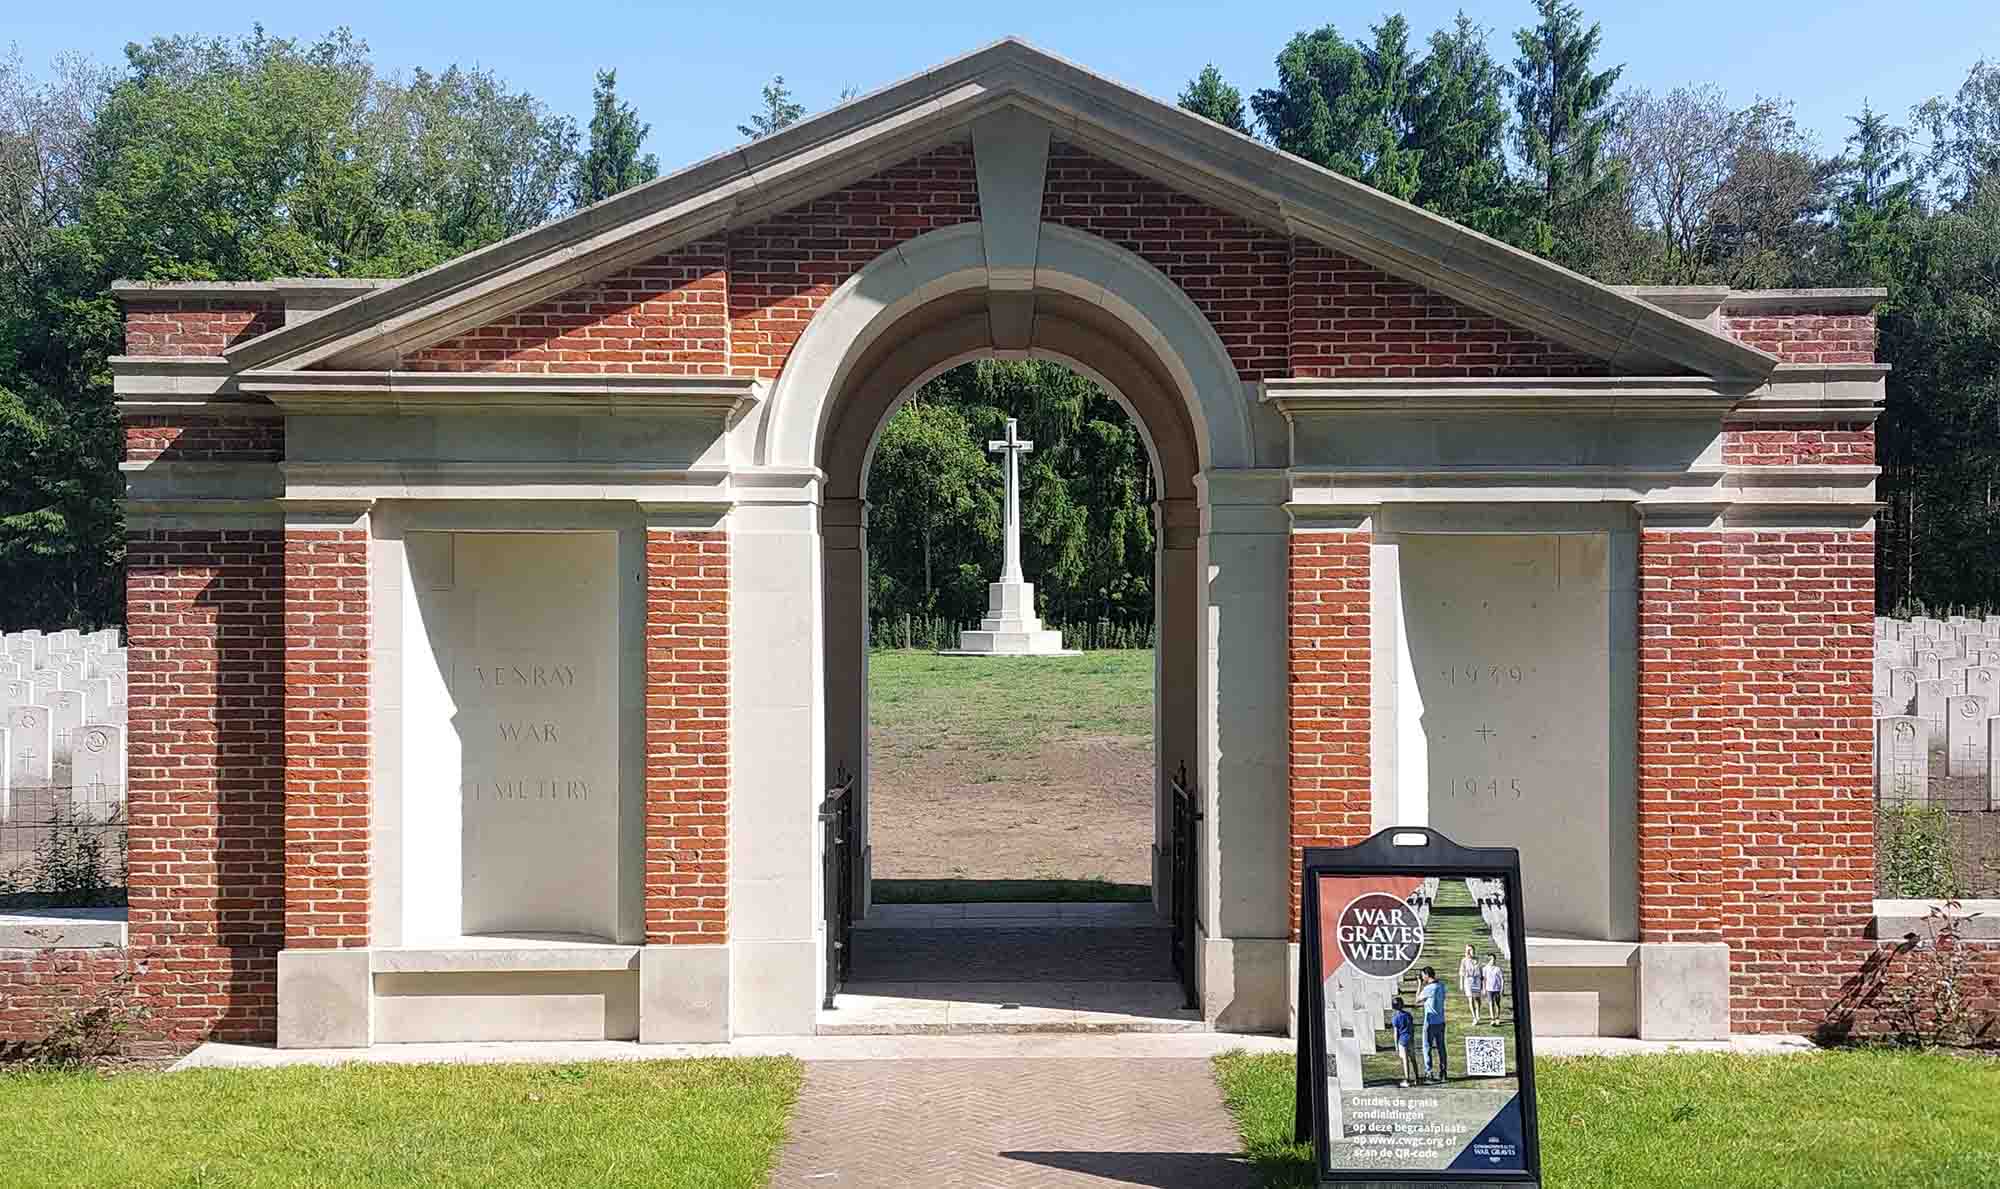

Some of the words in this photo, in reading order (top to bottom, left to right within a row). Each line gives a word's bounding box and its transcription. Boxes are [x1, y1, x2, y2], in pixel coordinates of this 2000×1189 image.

[473, 664, 577, 688] VENRAY
[1448, 664, 1523, 688] 1939
[497, 720, 560, 744] WAR
[1448, 776, 1522, 800] 1945
[1353, 908, 1407, 926] WAR
[1339, 925, 1423, 943] GRAVES
[1348, 943, 1412, 961] WEEK
[1352, 1096, 1391, 1107] Ontdek
[1392, 1096, 1406, 1107] de
[1407, 1097, 1439, 1110] gratis
[1353, 1123, 1366, 1134] op
[1368, 1122, 1392, 1132] deze
[1394, 1122, 1467, 1135] begraafplaats
[1353, 1136, 1366, 1146] op
[1368, 1136, 1444, 1148] www.cwgc.org
[1445, 1135, 1457, 1146] of
[1353, 1149, 1378, 1158] scan
[1379, 1147, 1393, 1158] de
[1395, 1148, 1439, 1159] QR-code
